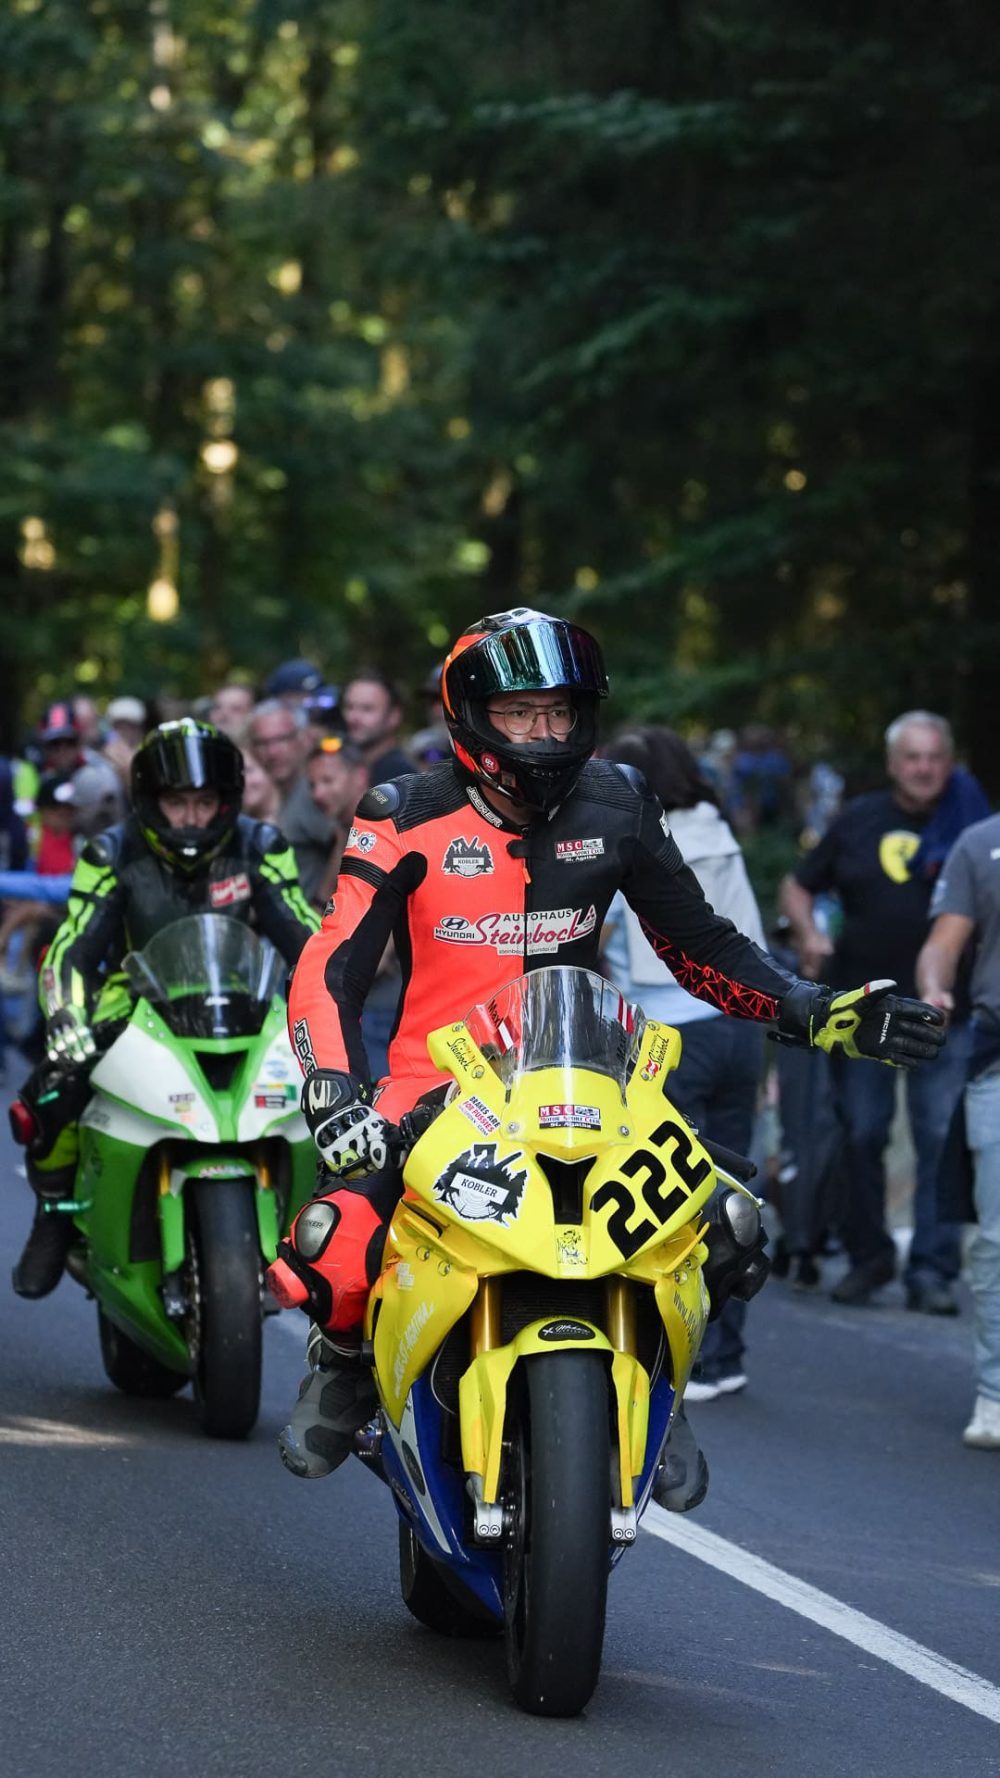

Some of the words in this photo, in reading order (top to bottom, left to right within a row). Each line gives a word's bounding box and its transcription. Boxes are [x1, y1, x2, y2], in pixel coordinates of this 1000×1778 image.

[557, 841, 582, 852] MSC
[435, 929, 475, 939] HYUNDAI
[475, 911, 582, 945] Steinbock
[880, 1012, 891, 1044] RICHA
[469, 1096, 490, 1115] BRAKES
[487, 1114, 501, 1128] ARE
[472, 1109, 495, 1133] PUSSIES
[540, 1105, 574, 1117] MSC
[461, 1178, 498, 1198] KOBLER
[589, 1120, 712, 1261] 222
